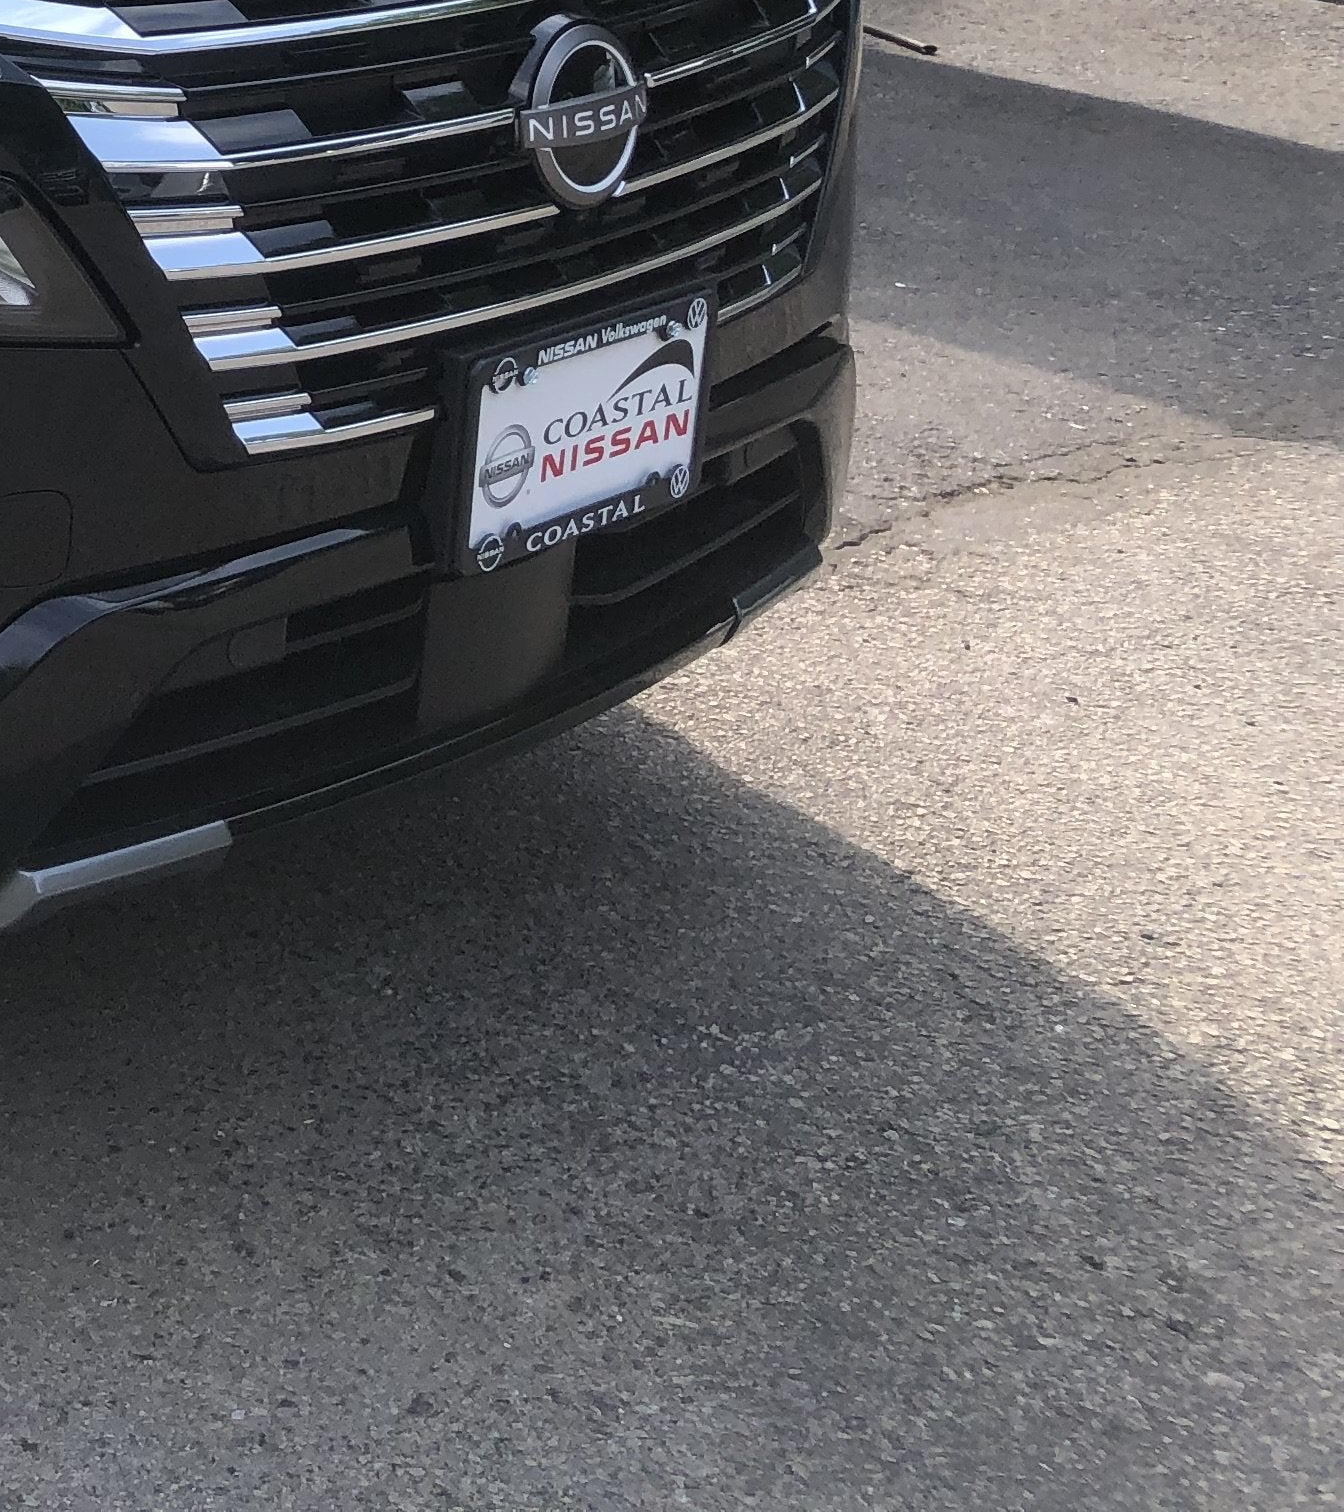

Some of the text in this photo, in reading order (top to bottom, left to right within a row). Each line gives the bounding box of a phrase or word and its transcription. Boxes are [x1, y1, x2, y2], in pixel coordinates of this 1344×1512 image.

[529, 91, 647, 141] NISSAN
[538, 315, 667, 365] NISSAN Volkswagen
[543, 379, 692, 445] COASTAL
[485, 453, 530, 479] NISSAN
[540, 409, 690, 482] NISSAN
[526, 494, 645, 551] COASTAL
